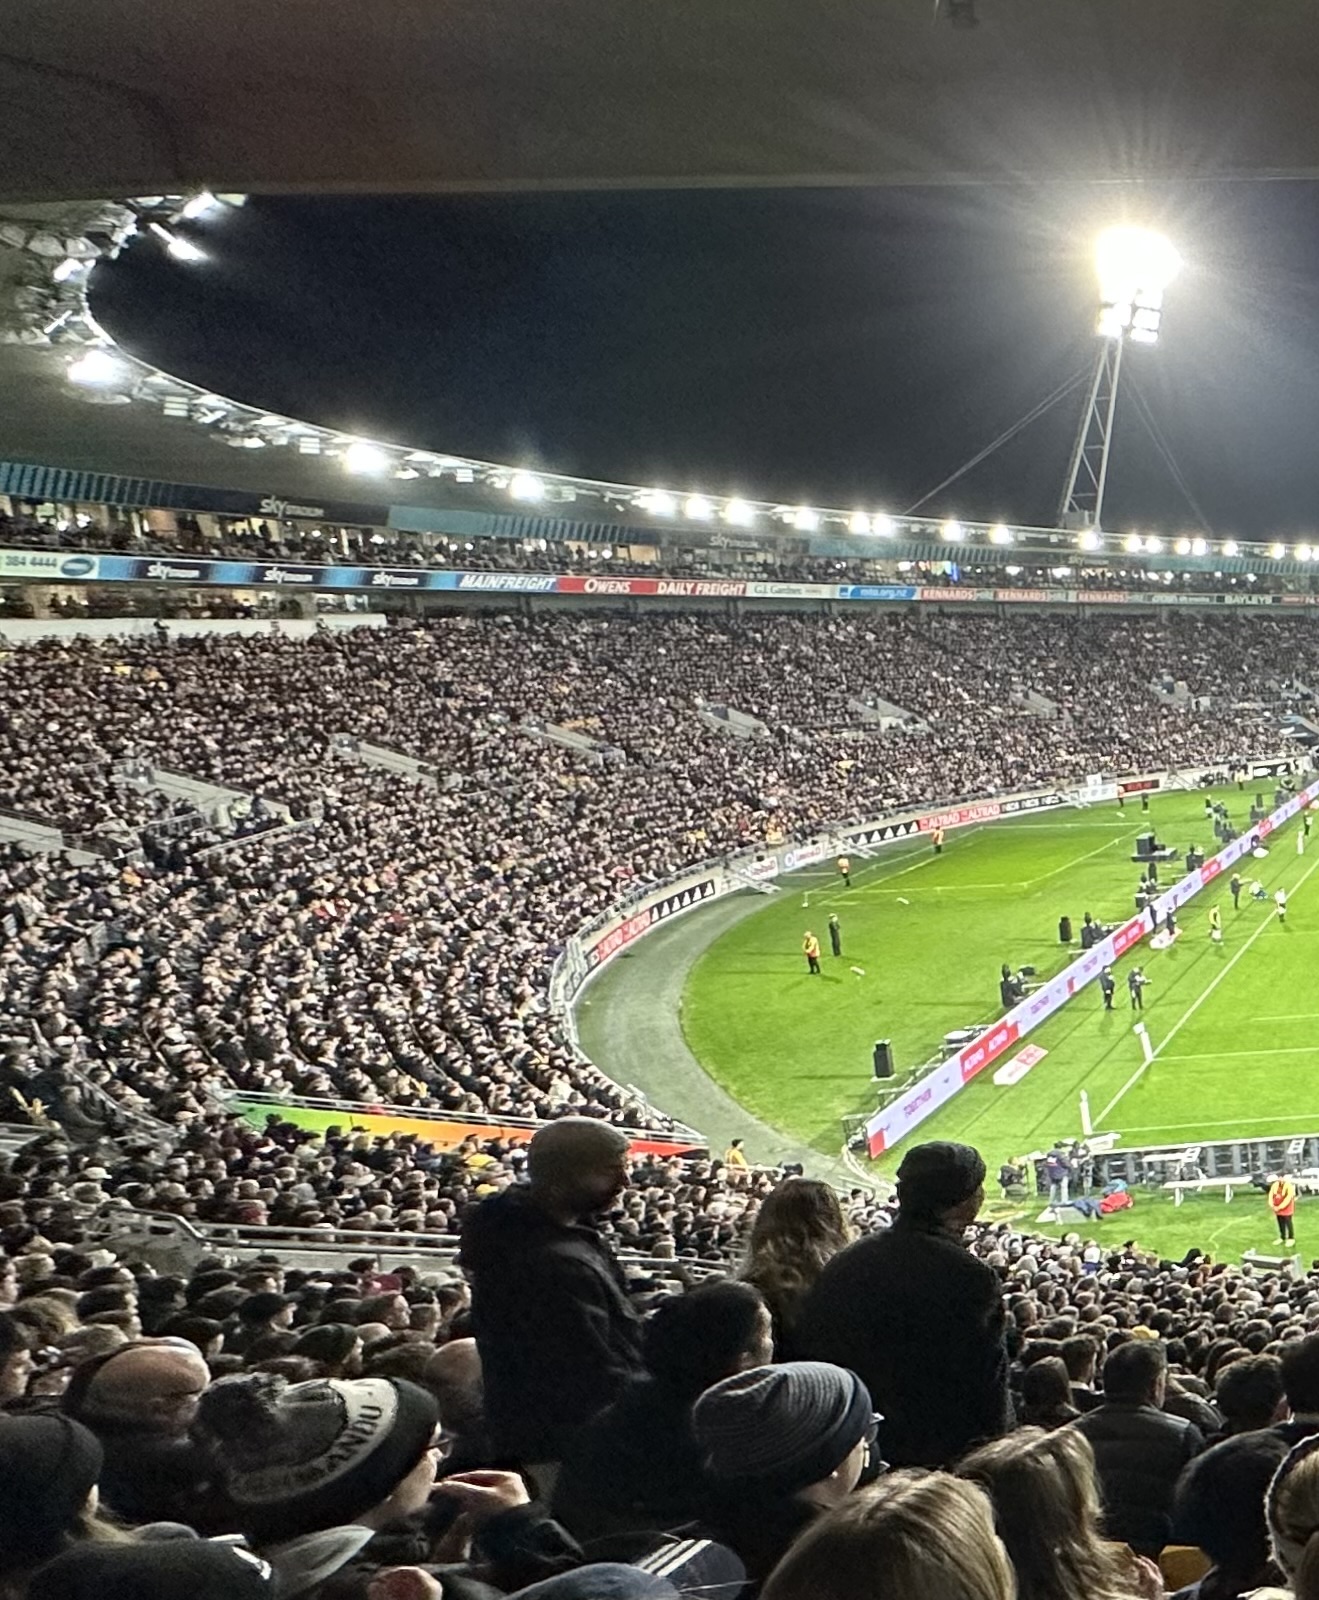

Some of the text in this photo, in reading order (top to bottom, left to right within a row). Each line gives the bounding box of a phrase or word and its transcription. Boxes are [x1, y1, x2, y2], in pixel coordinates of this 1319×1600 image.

[459, 574, 556, 591] MAINFREIGHT
[657, 581, 745, 596] DAILY FREIGHT
